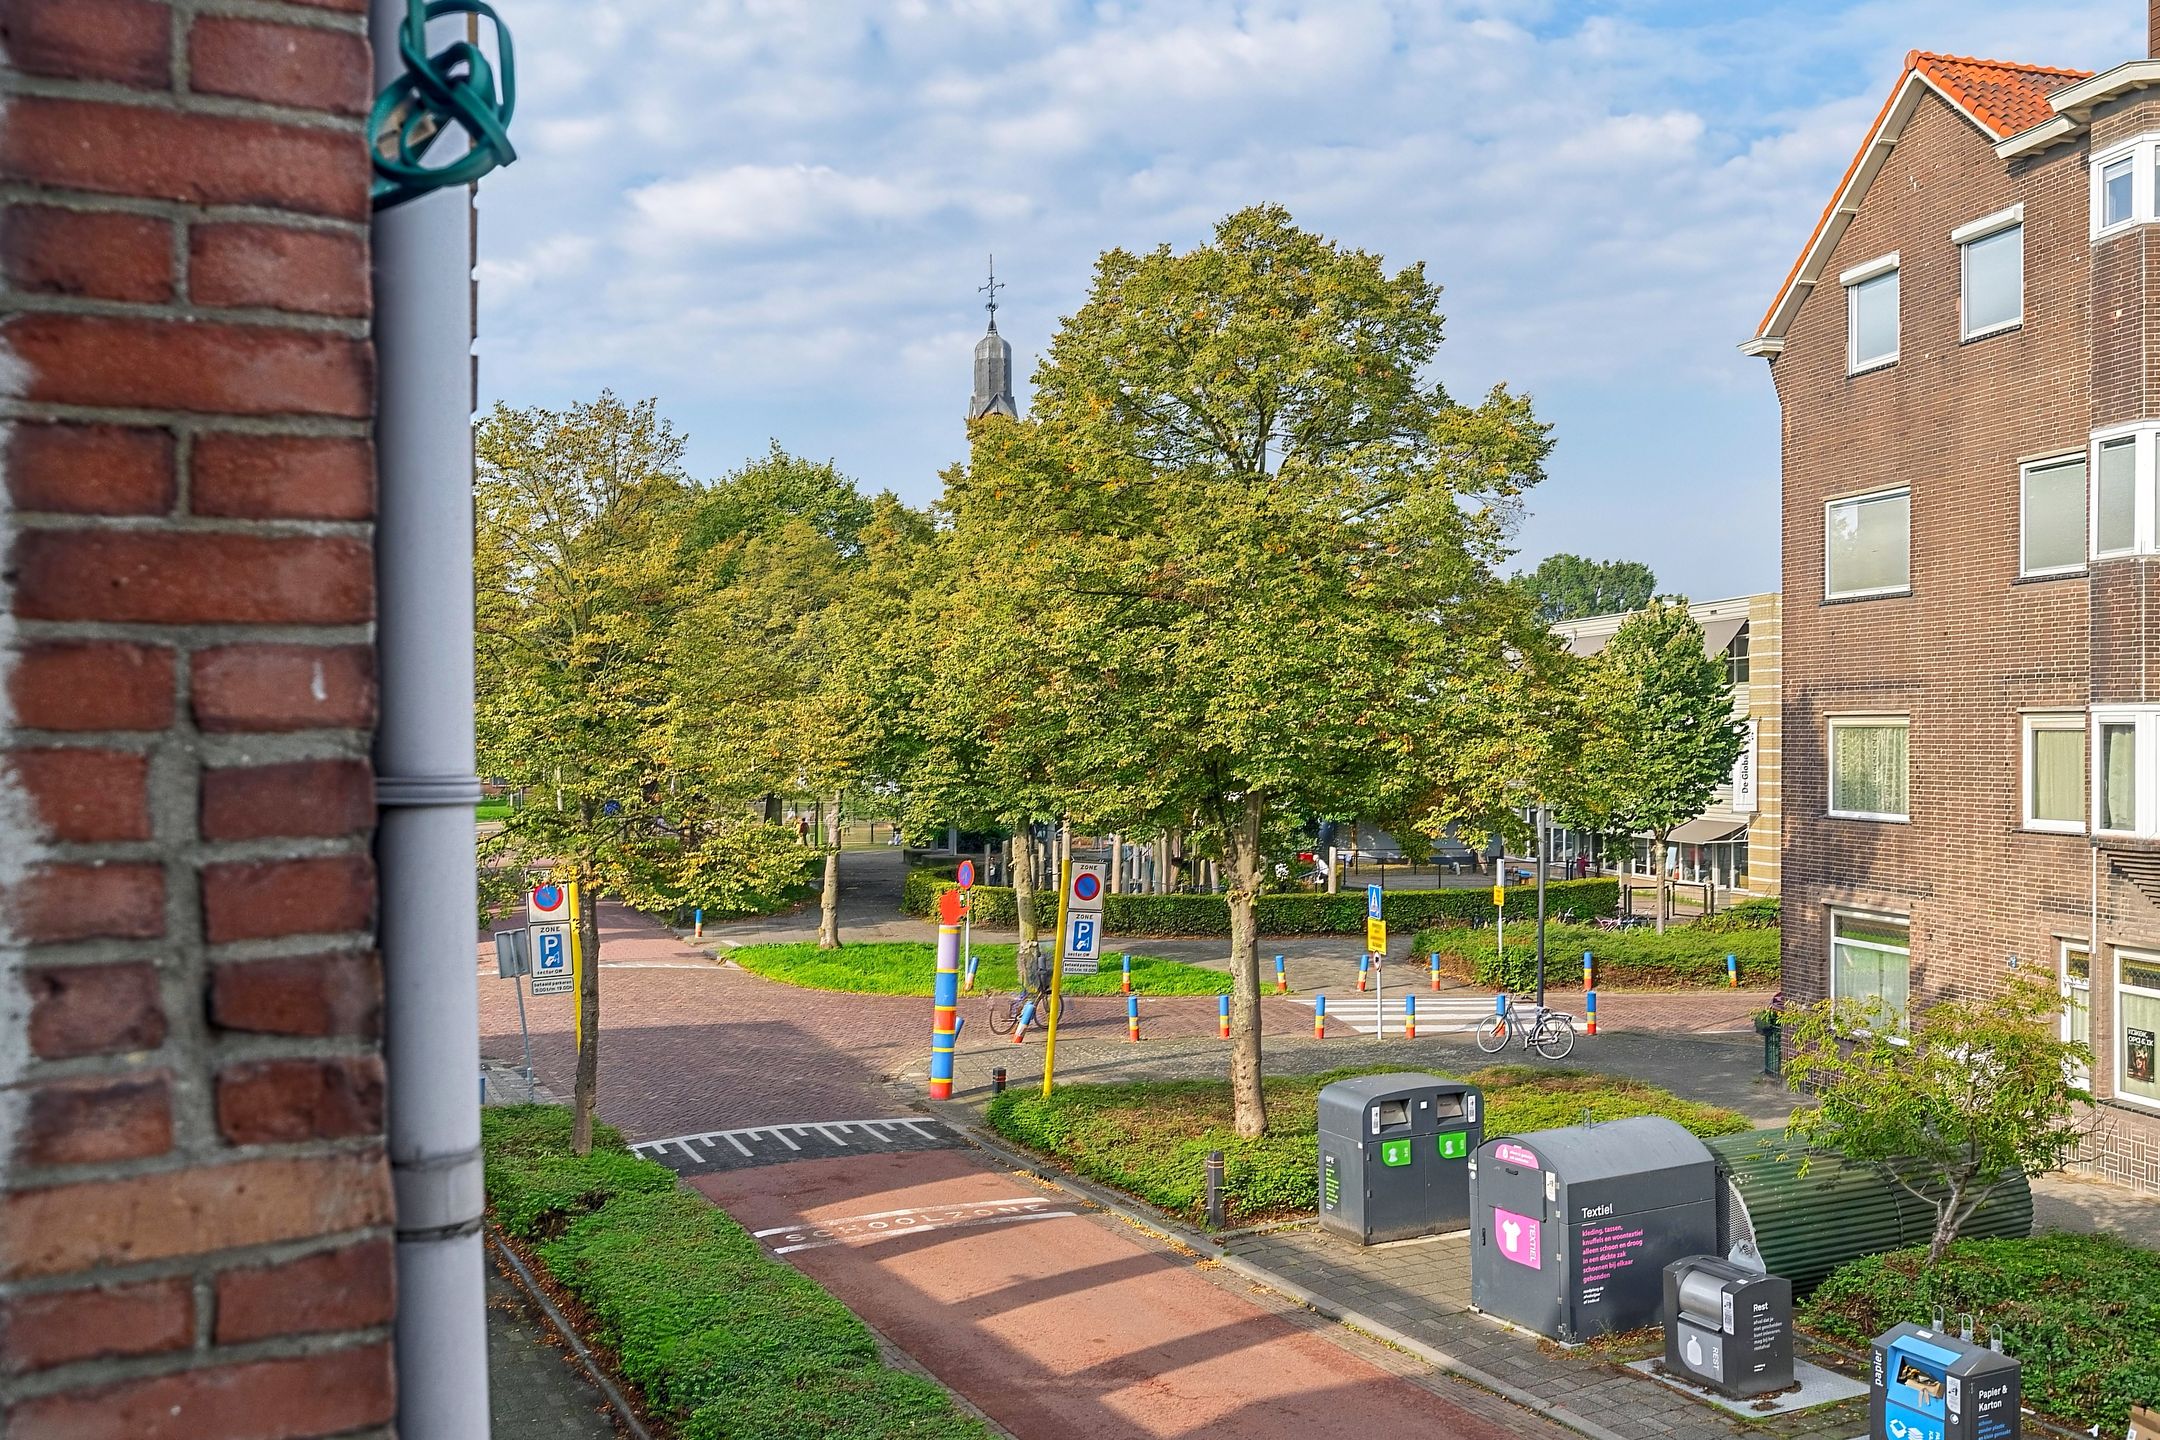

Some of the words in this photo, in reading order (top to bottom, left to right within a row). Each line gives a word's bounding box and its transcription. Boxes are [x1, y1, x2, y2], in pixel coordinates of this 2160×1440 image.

[1742, 781, 1748, 794] De
[1078, 923, 1089, 939] P
[544, 936, 558, 955] P
[1582, 1203, 1613, 1218] Textiel
[785, 1202, 1048, 1242] SCHOOLZONE
[1582, 1228, 1603, 1237] kleding,
[1582, 1237, 1604, 1246] knuffels
[1612, 1229, 1643, 1241] woontextiel
[1600, 1243, 1618, 1252] schoon
[1626, 1239, 1643, 1247] droog
[1600, 1252, 1616, 1261] dichte
[1583, 1263, 1608, 1274] schoenen
[1583, 1272, 1610, 1284] gebonden
[1753, 1302, 1768, 1312] Rest
[1874, 1350, 1884, 1387] papier
[1978, 1387, 2001, 1399] Papier
[2002, 1384, 2008, 1394] &
[1978, 1400, 2002, 1412] Karton
